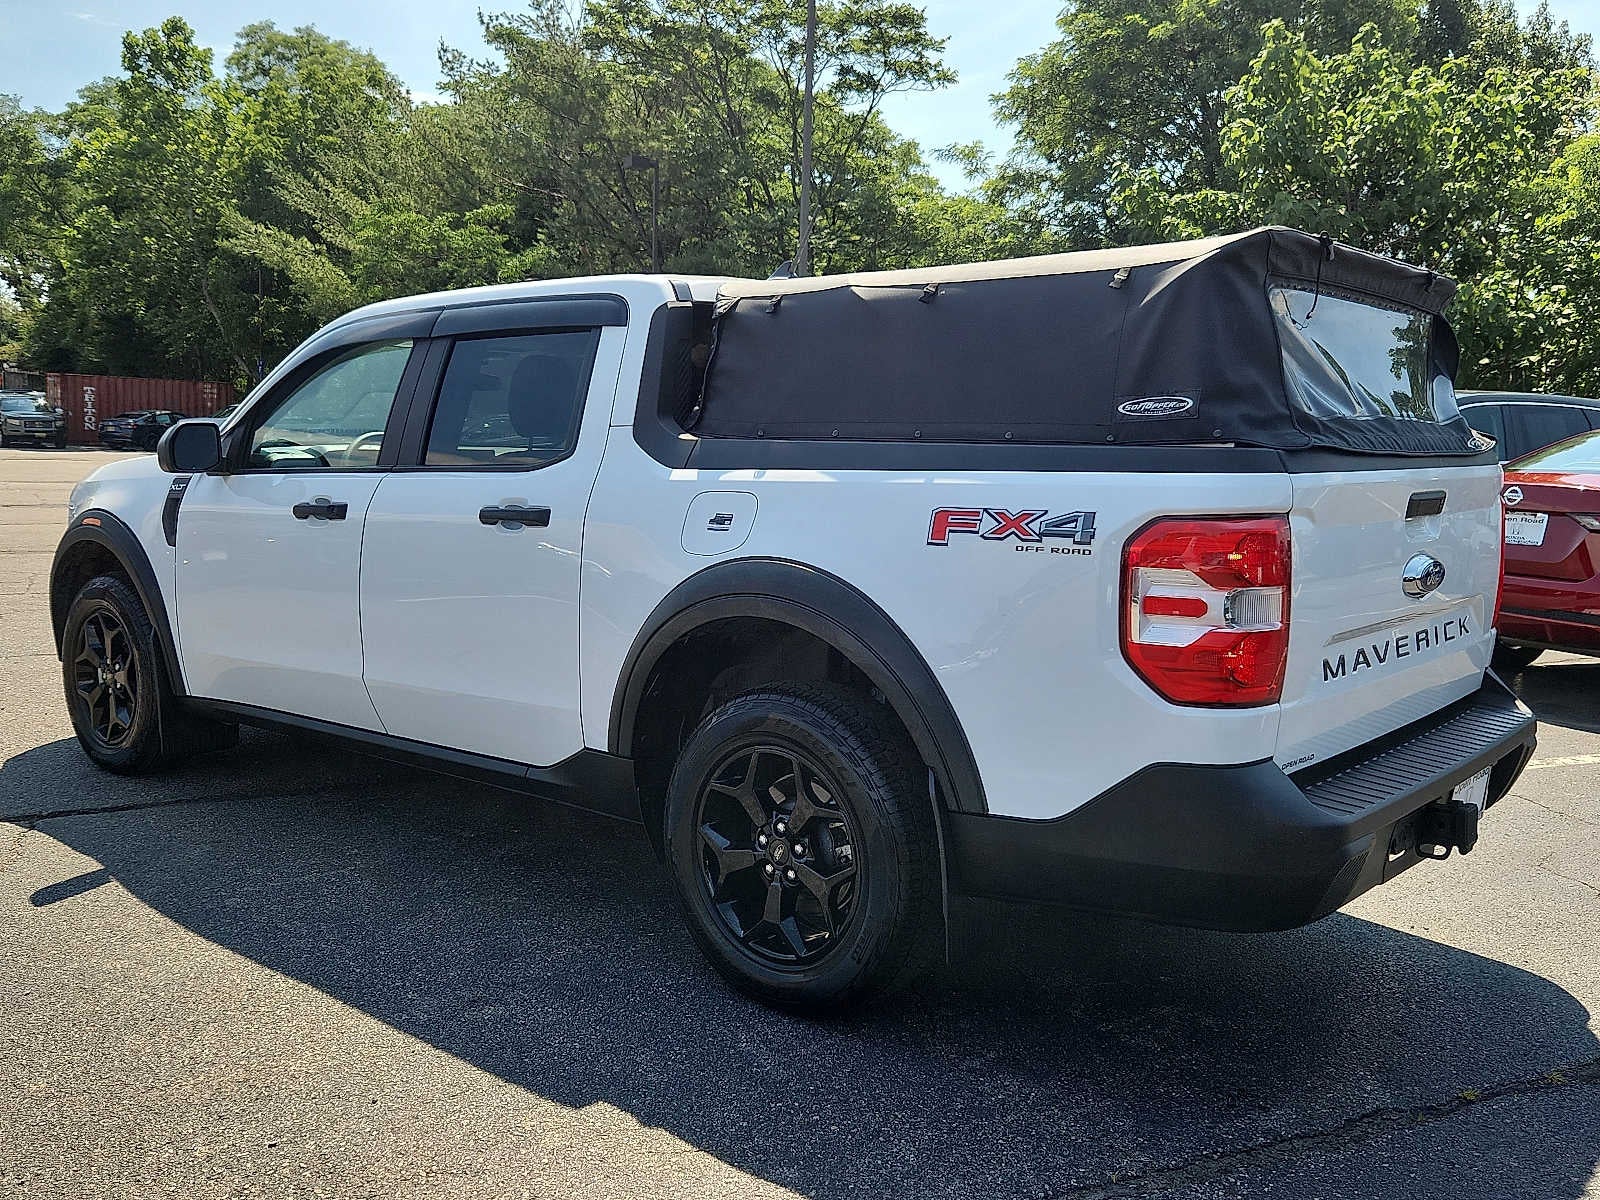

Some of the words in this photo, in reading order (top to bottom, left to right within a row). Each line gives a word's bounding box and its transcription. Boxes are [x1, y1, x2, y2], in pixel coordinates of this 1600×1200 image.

[83, 386, 96, 430] TRITON
[926, 506, 1097, 546] FX4
[1015, 545, 1045, 553] OFF
[1050, 547, 1093, 556] ROAD
[1321, 615, 1471, 683] MAVERICK
